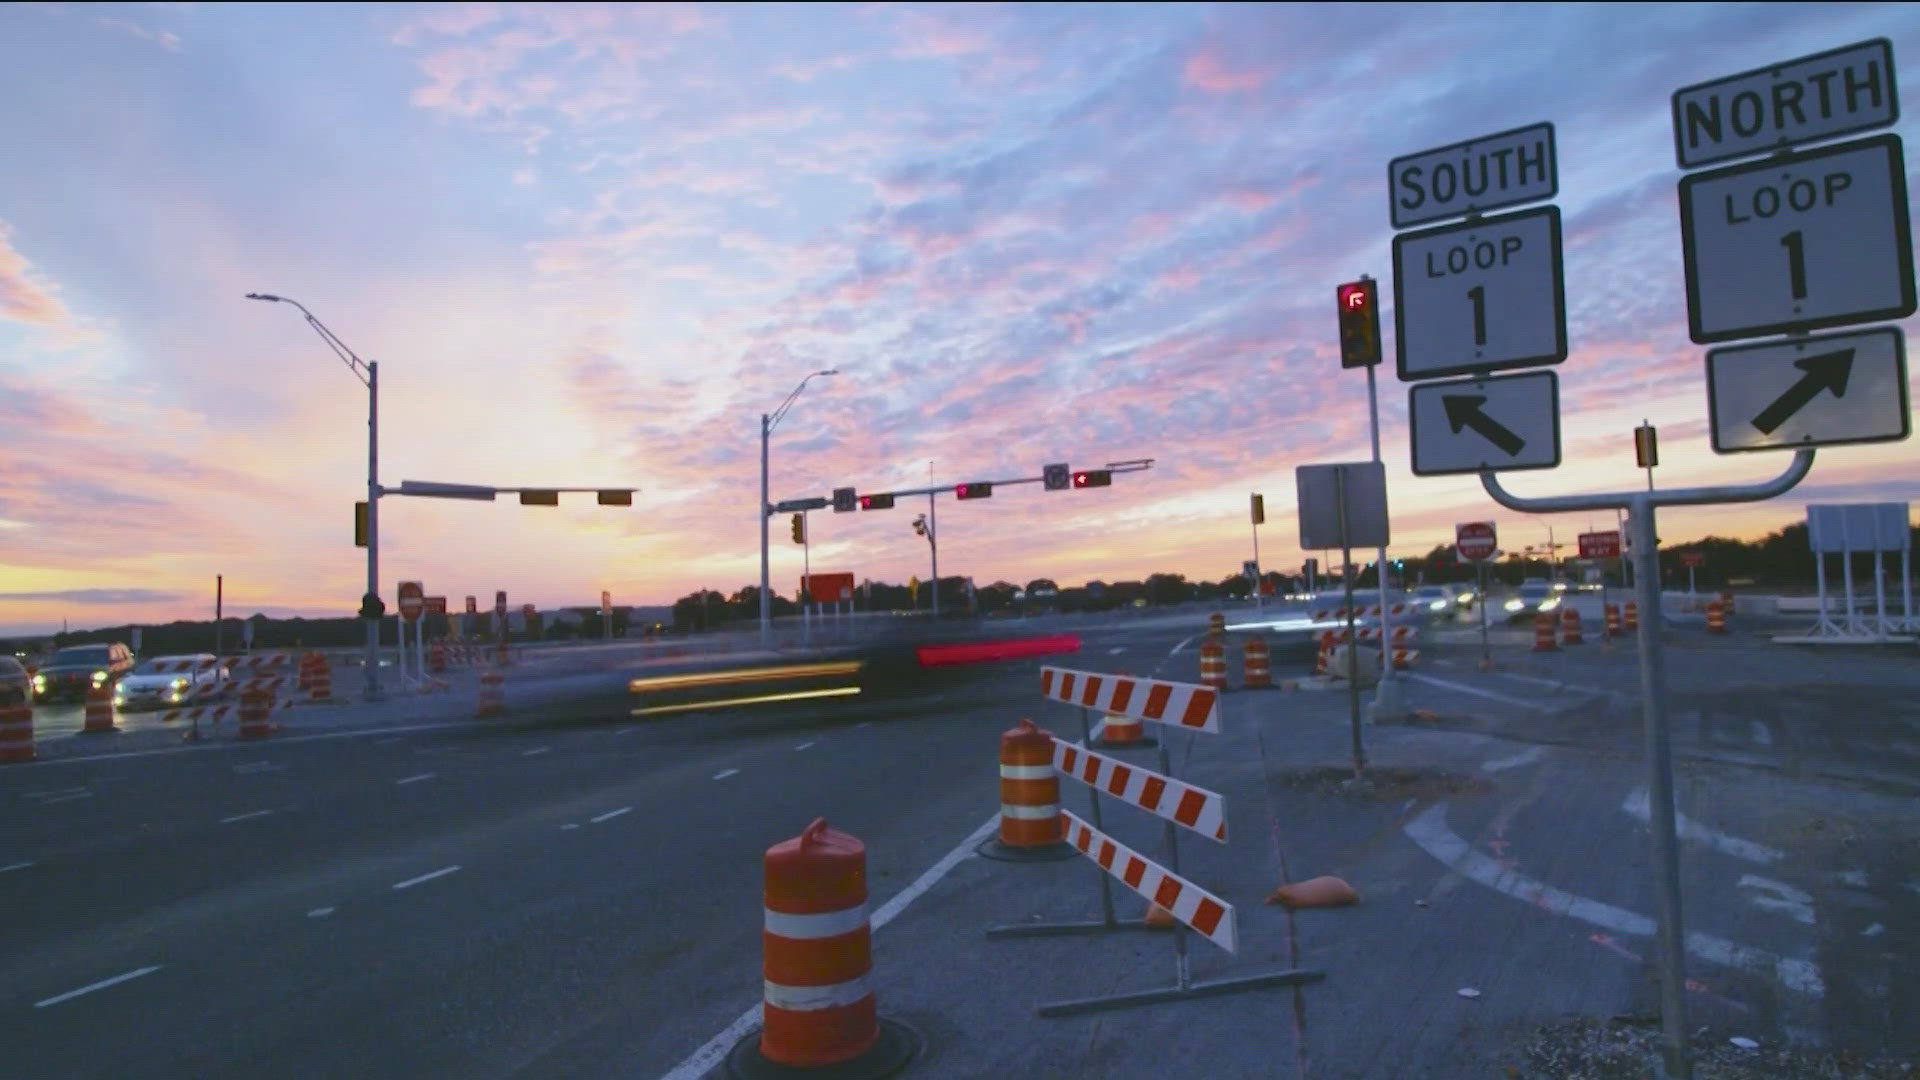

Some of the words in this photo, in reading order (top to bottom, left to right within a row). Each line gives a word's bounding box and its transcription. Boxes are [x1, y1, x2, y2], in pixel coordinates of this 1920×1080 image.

[1686, 60, 1882, 148] NORTH
[1400, 141, 1545, 209] SOUTH
[1725, 172, 1852, 225] LOOP
[1427, 236, 1523, 278] LOOP
[1780, 230, 1807, 300] 1
[1467, 285, 1487, 346] 1
